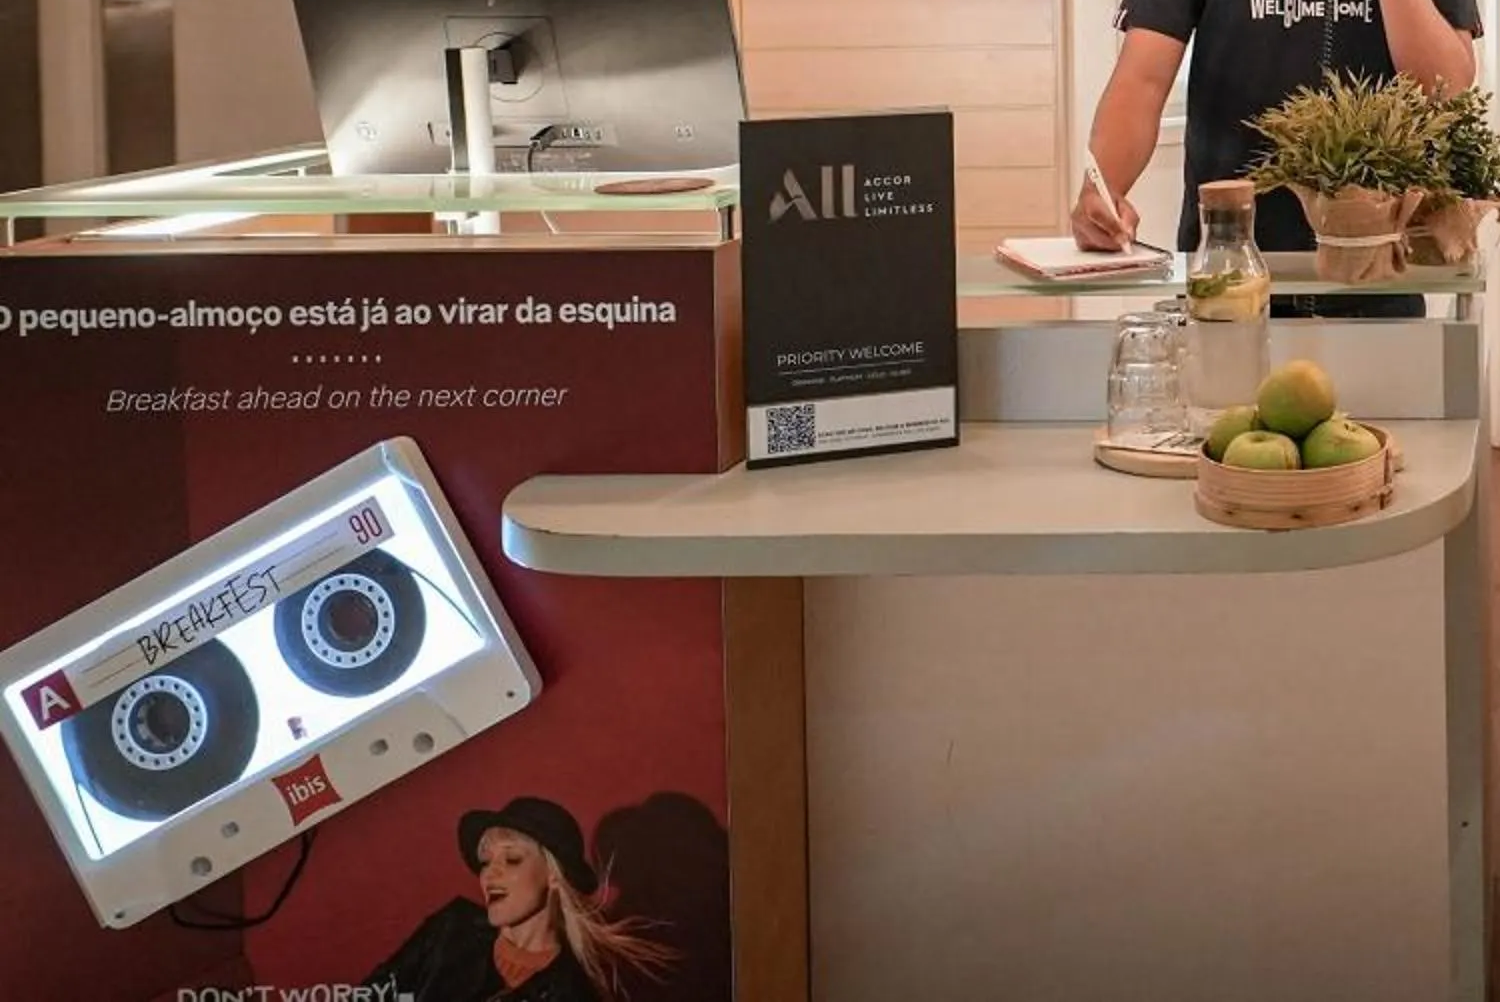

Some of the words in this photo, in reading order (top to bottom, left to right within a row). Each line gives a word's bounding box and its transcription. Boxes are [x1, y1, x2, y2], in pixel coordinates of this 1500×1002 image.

[863, 191, 894, 203] LIVE
[864, 175, 912, 187] ACCOR
[864, 203, 934, 217] LIMITLESS
[19, 299, 282, 337] pequeno-almoço
[289, 297, 356, 327] está
[361, 298, 388, 332] já
[395, 304, 432, 325] ao
[438, 297, 509, 325] virar
[515, 296, 551, 323] da
[559, 295, 677, 330] esquina
[776, 349, 846, 367] PRIORITY
[850, 341, 925, 359] WELCOME
[106, 386, 233, 413] Breakfast
[237, 385, 322, 410] ahead
[328, 390, 361, 409] on
[369, 384, 411, 408] the
[416, 385, 477, 407] next
[483, 386, 569, 407] corner
[348, 506, 384, 546] 90
[136, 565, 284, 666] BREAKFEST
[38, 685, 71, 720] A
[287, 772, 328, 807] ibis
